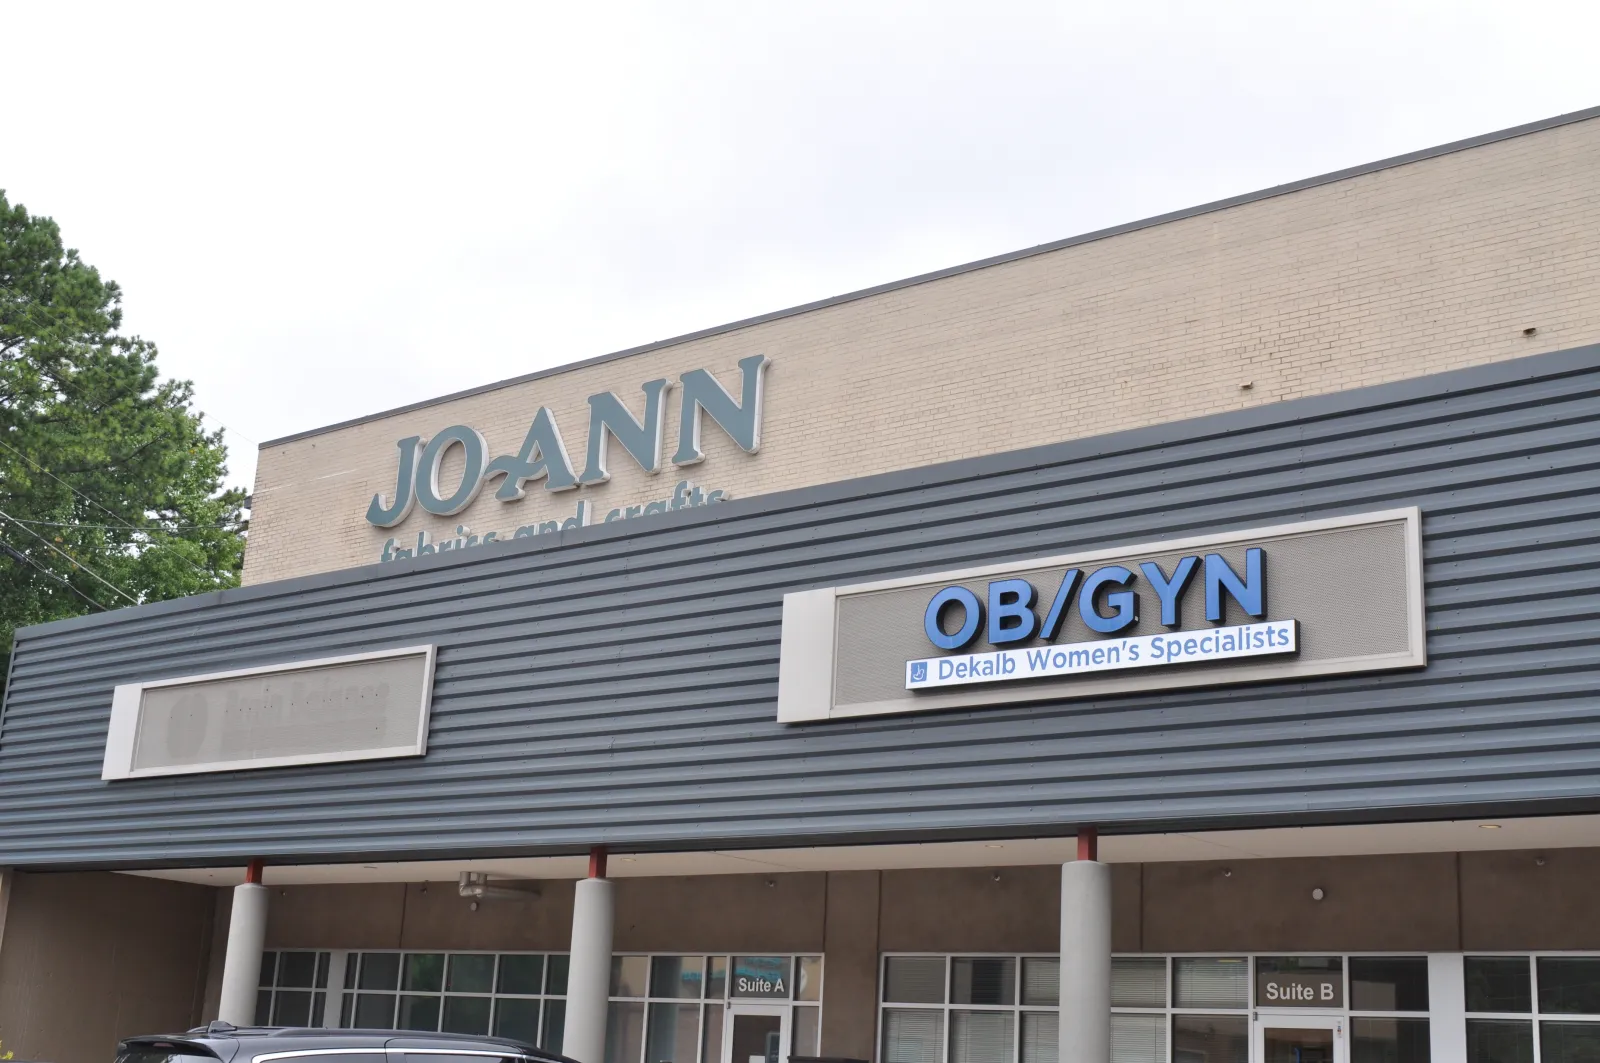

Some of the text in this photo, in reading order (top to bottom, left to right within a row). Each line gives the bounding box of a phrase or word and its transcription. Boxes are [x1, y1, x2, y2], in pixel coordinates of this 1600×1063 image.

[366, 354, 771, 528] JOANN
[923, 547, 1266, 650] OB/GYN
[938, 625, 1290, 680] Dekalb Women's Specialists
[738, 977, 785, 992] Suite A
[1265, 982, 1334, 1001] Suite B
